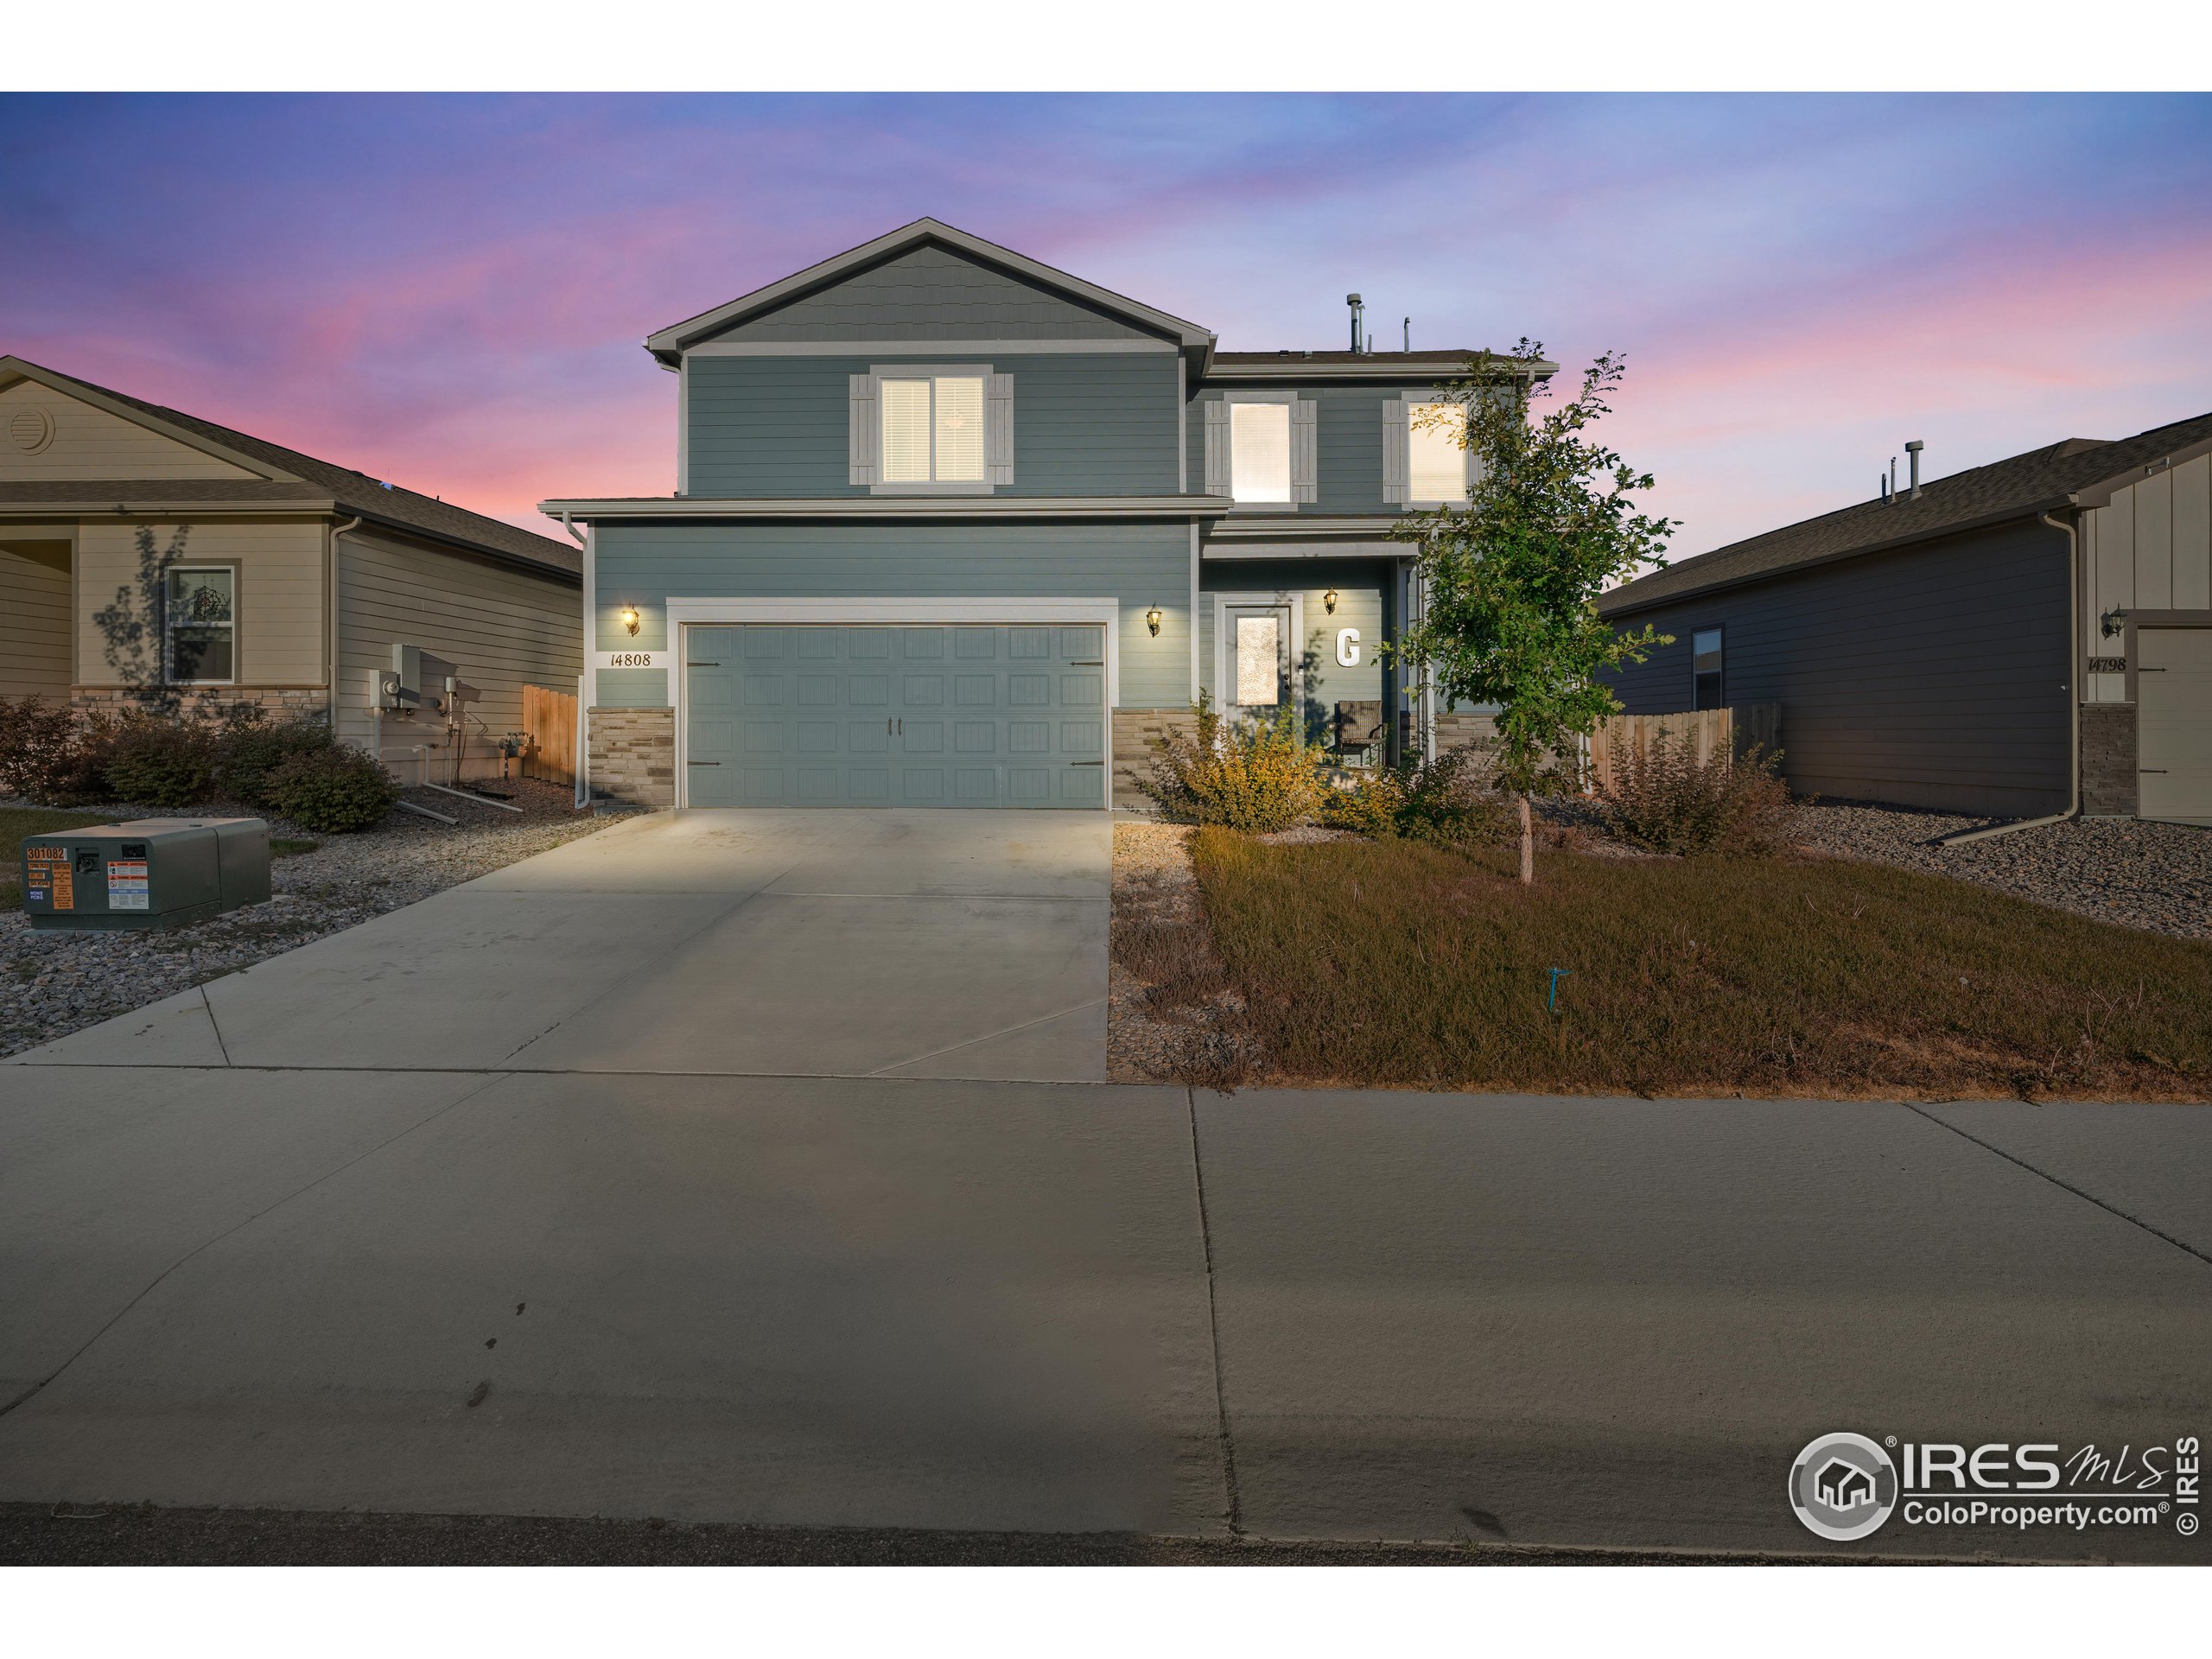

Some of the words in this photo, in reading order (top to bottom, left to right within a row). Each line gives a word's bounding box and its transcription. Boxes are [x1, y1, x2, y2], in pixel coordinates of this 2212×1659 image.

[1335, 627, 1361, 668] G
[611, 653, 651, 667] 14808
[2088, 658, 2126, 672] 14798
[28, 848, 64, 859] 301082
